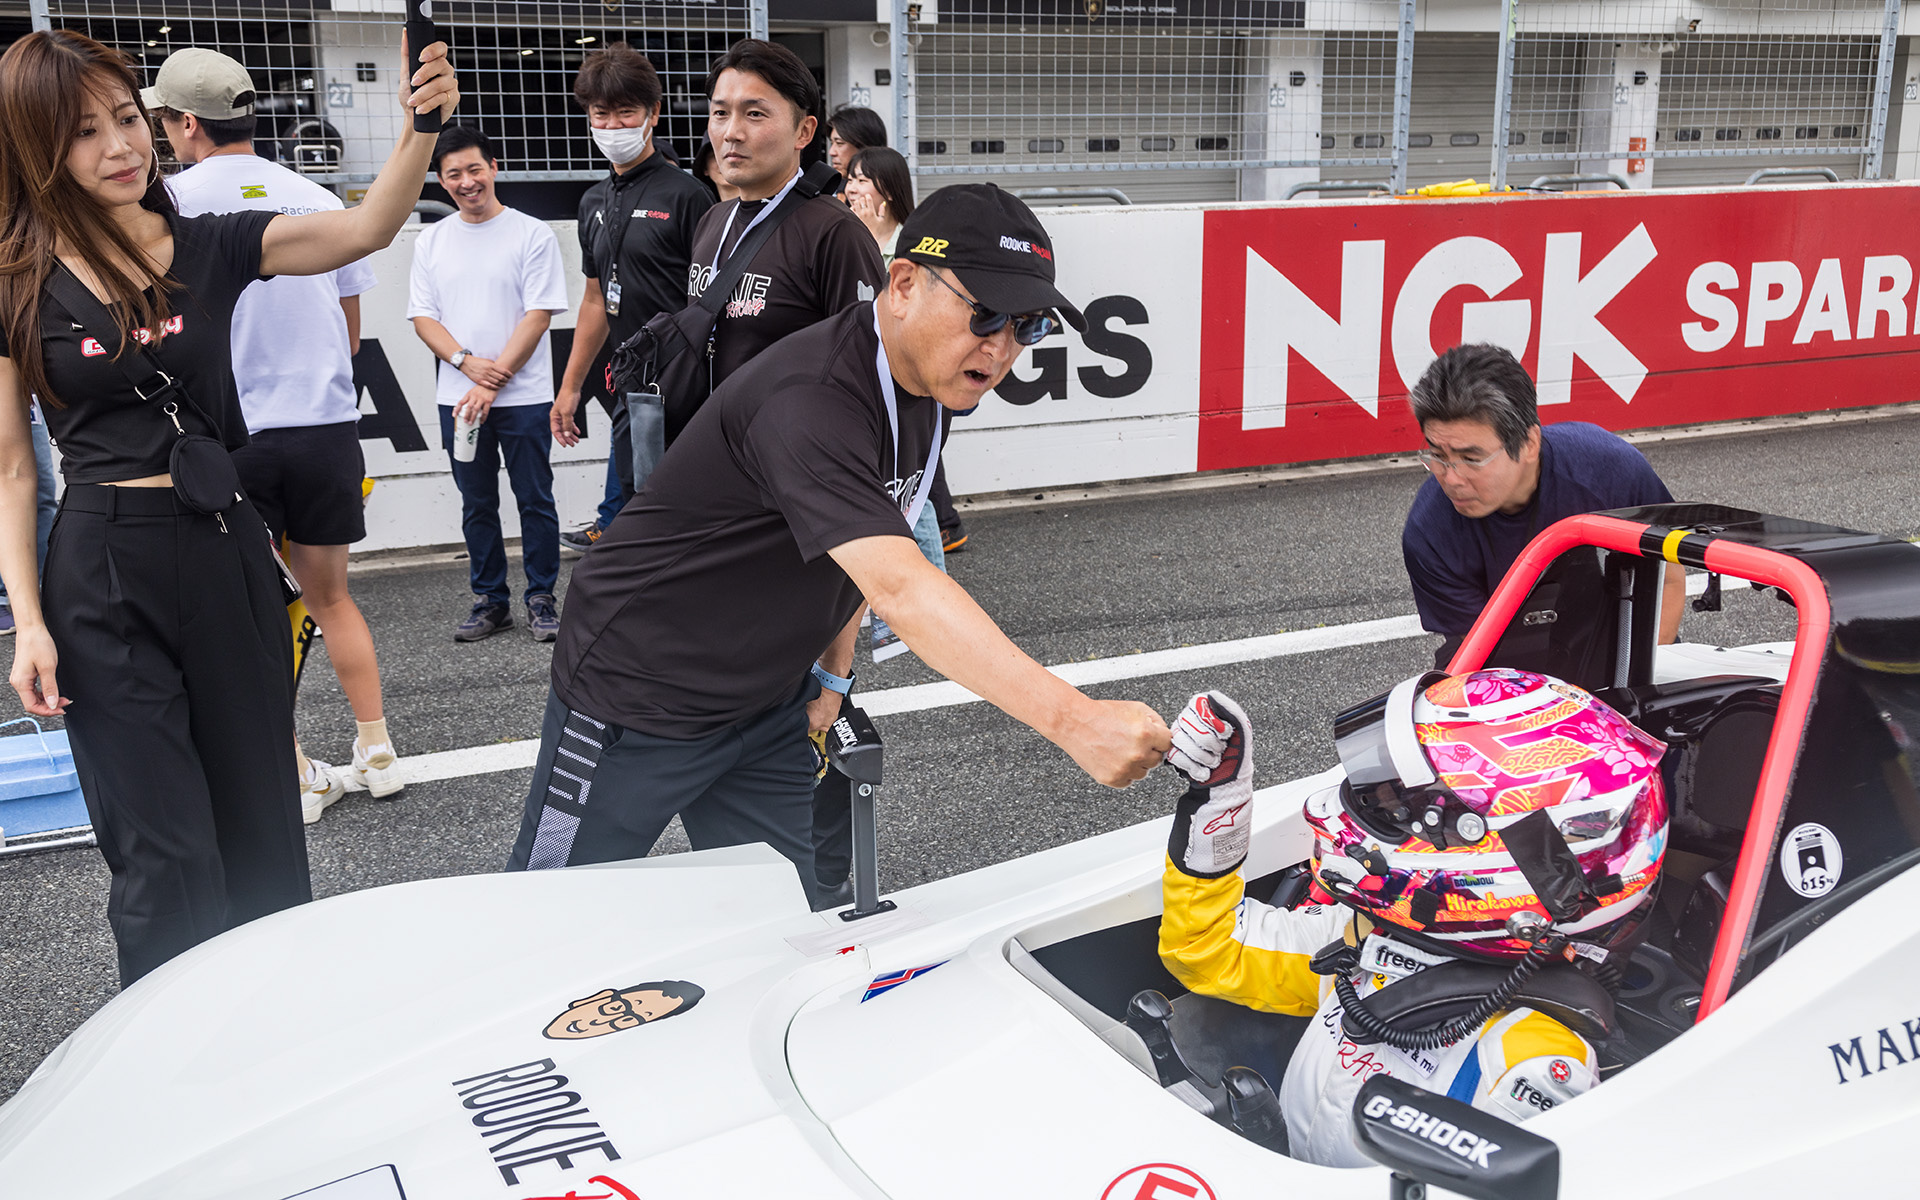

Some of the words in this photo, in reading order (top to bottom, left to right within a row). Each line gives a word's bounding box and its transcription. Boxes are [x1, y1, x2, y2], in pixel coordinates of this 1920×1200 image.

[329, 86, 351, 105] 27
[852, 89, 871, 107] 26
[1270, 89, 1286, 106] 25
[913, 236, 950, 258] RR
[999, 235, 1032, 254] ROOKIE
[1242, 221, 1658, 431] NGK
[1681, 254, 1920, 353] SPAR
[1444, 891, 1539, 912] Hirakawa
[451, 1057, 623, 1187] ROOKIE
[1362, 1094, 1502, 1170] G-SHOCK
